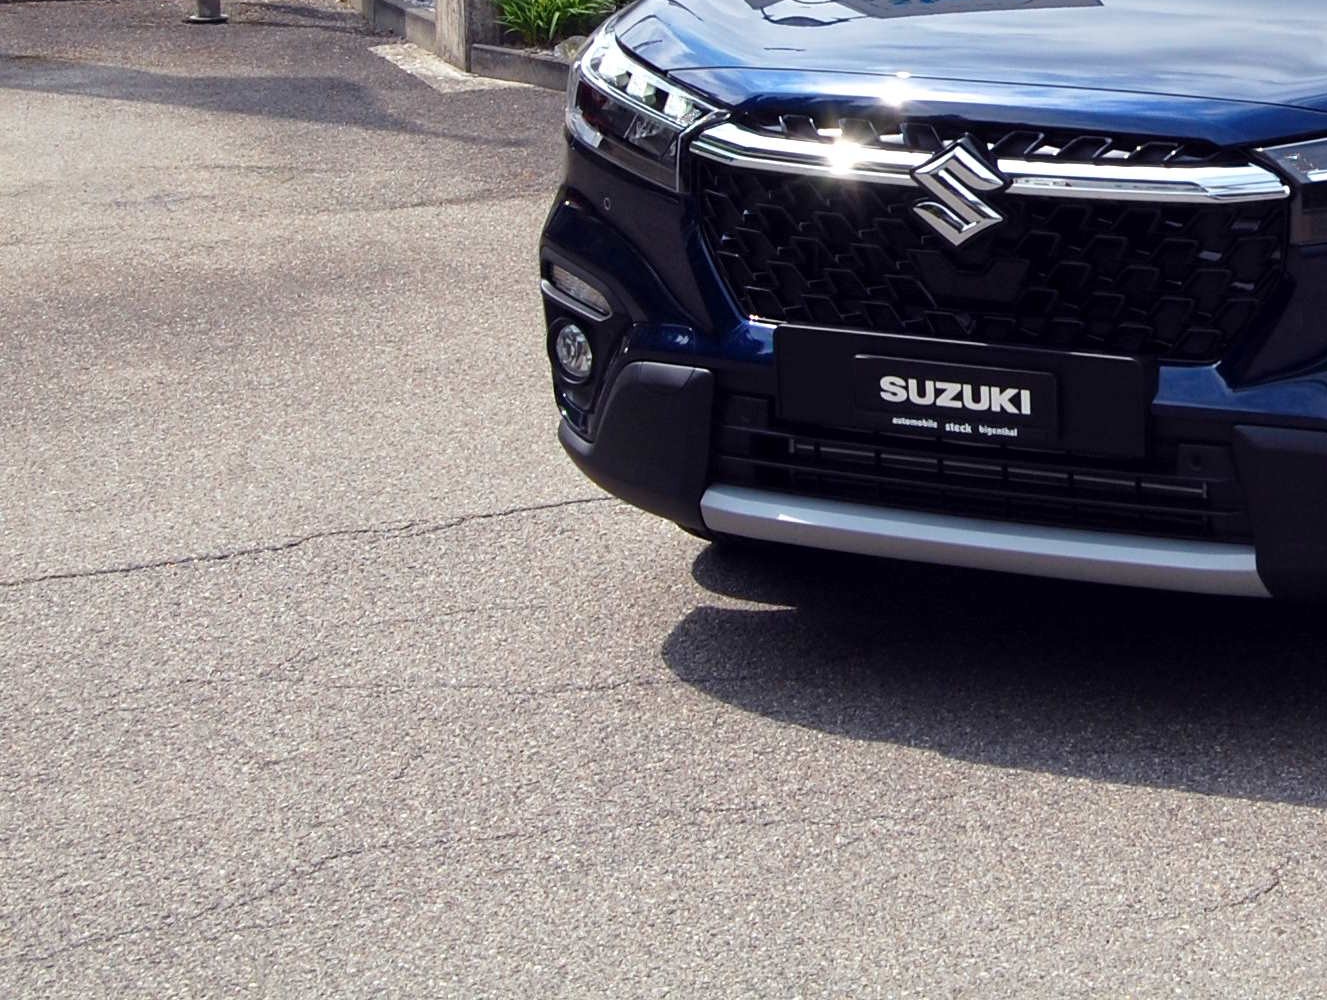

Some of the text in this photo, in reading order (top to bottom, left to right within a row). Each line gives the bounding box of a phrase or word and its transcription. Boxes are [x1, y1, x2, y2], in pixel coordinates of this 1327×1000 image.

[879, 375, 1031, 415] SUZUKI
[891, 417, 938, 429] automobile
[944, 422, 973, 434] steck
